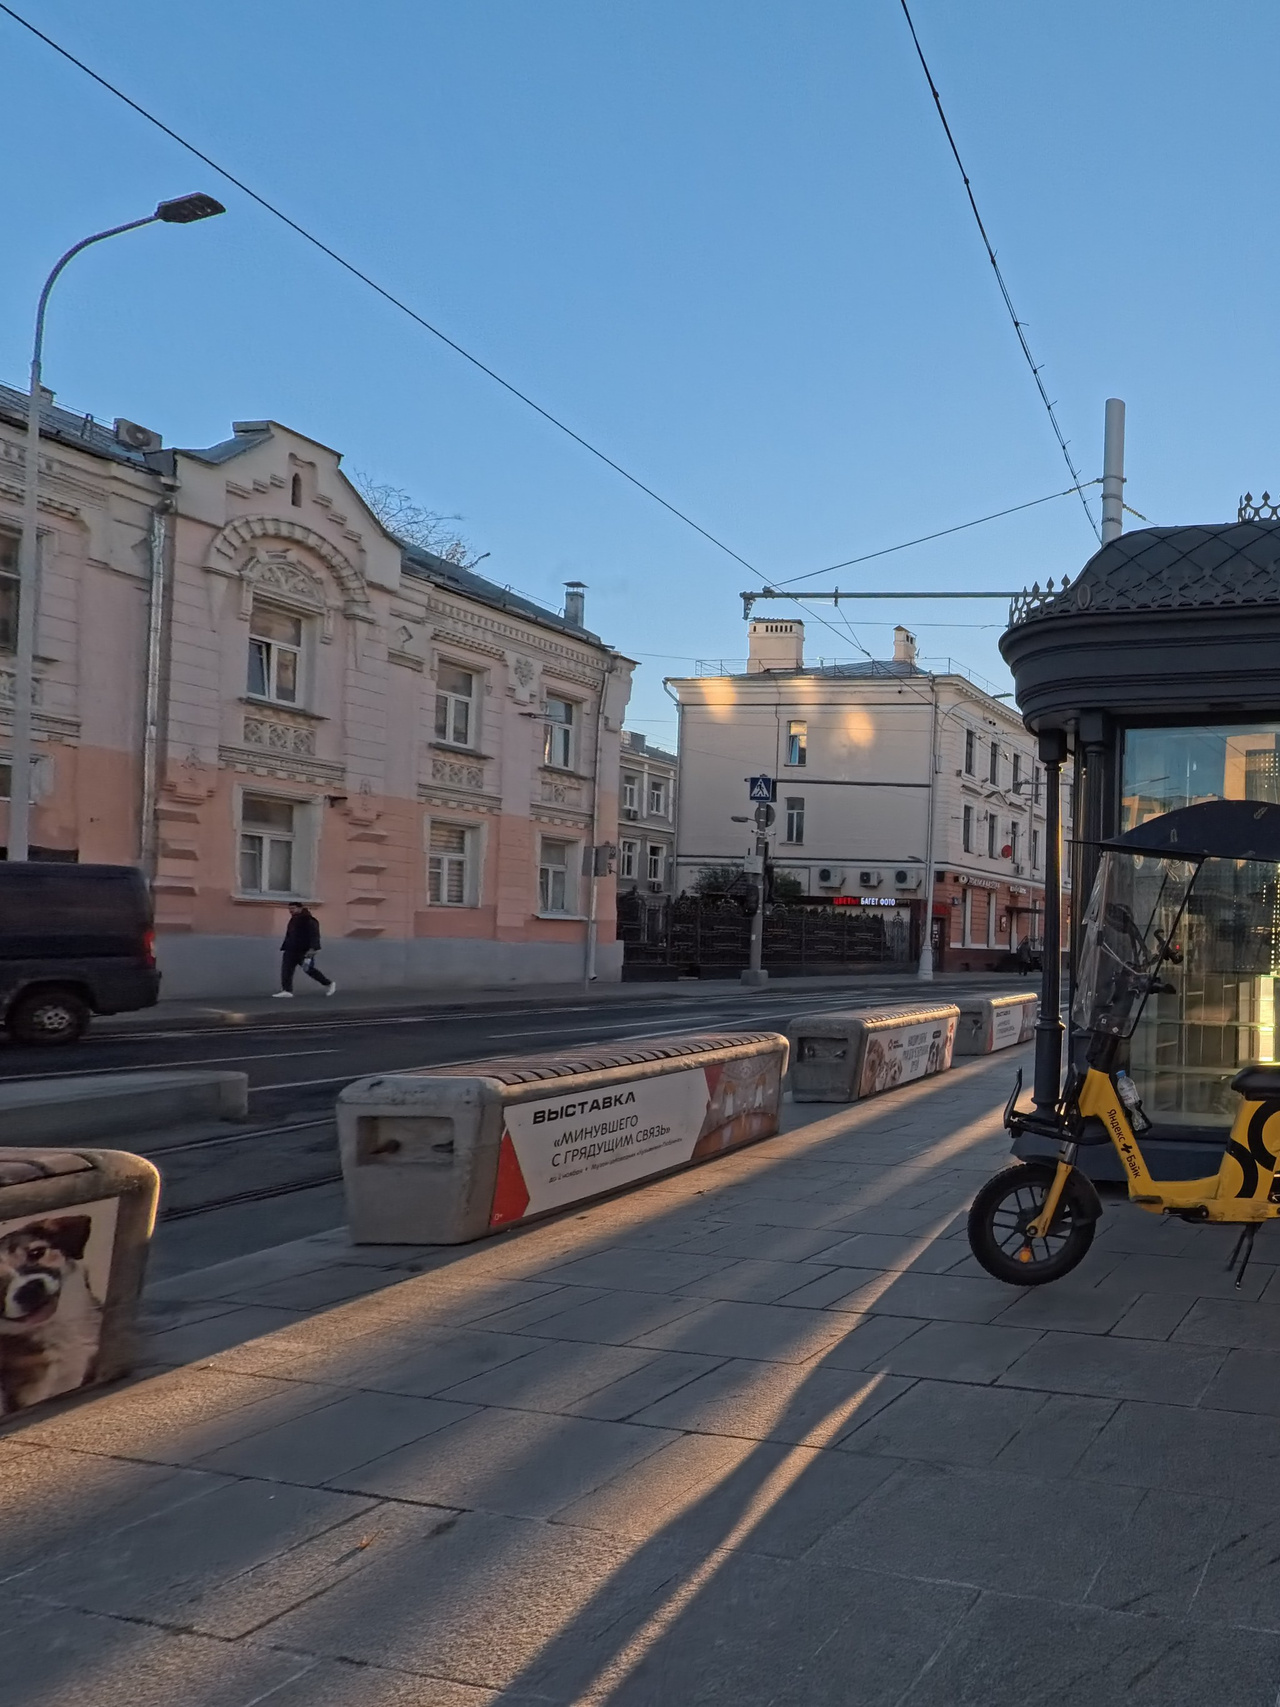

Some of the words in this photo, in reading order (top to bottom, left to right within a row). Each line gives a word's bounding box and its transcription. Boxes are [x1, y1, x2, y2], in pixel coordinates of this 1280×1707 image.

[860, 897, 878, 905] БАГЕТ
[879, 898, 896, 906] ФОТО
[532, 1091, 636, 1125] ВЫСТАВКА
[551, 1153, 561, 1167] С
[563, 1134, 634, 1165] ГРЯДУЩИМ
[635, 1124, 671, 1143] СВЯЗЬ»
[553, 1114, 639, 1148] «МИНУВШЕГО
[1107, 1108, 1126, 1142] Яндекс
[1126, 1154, 1141, 1179] Байк
